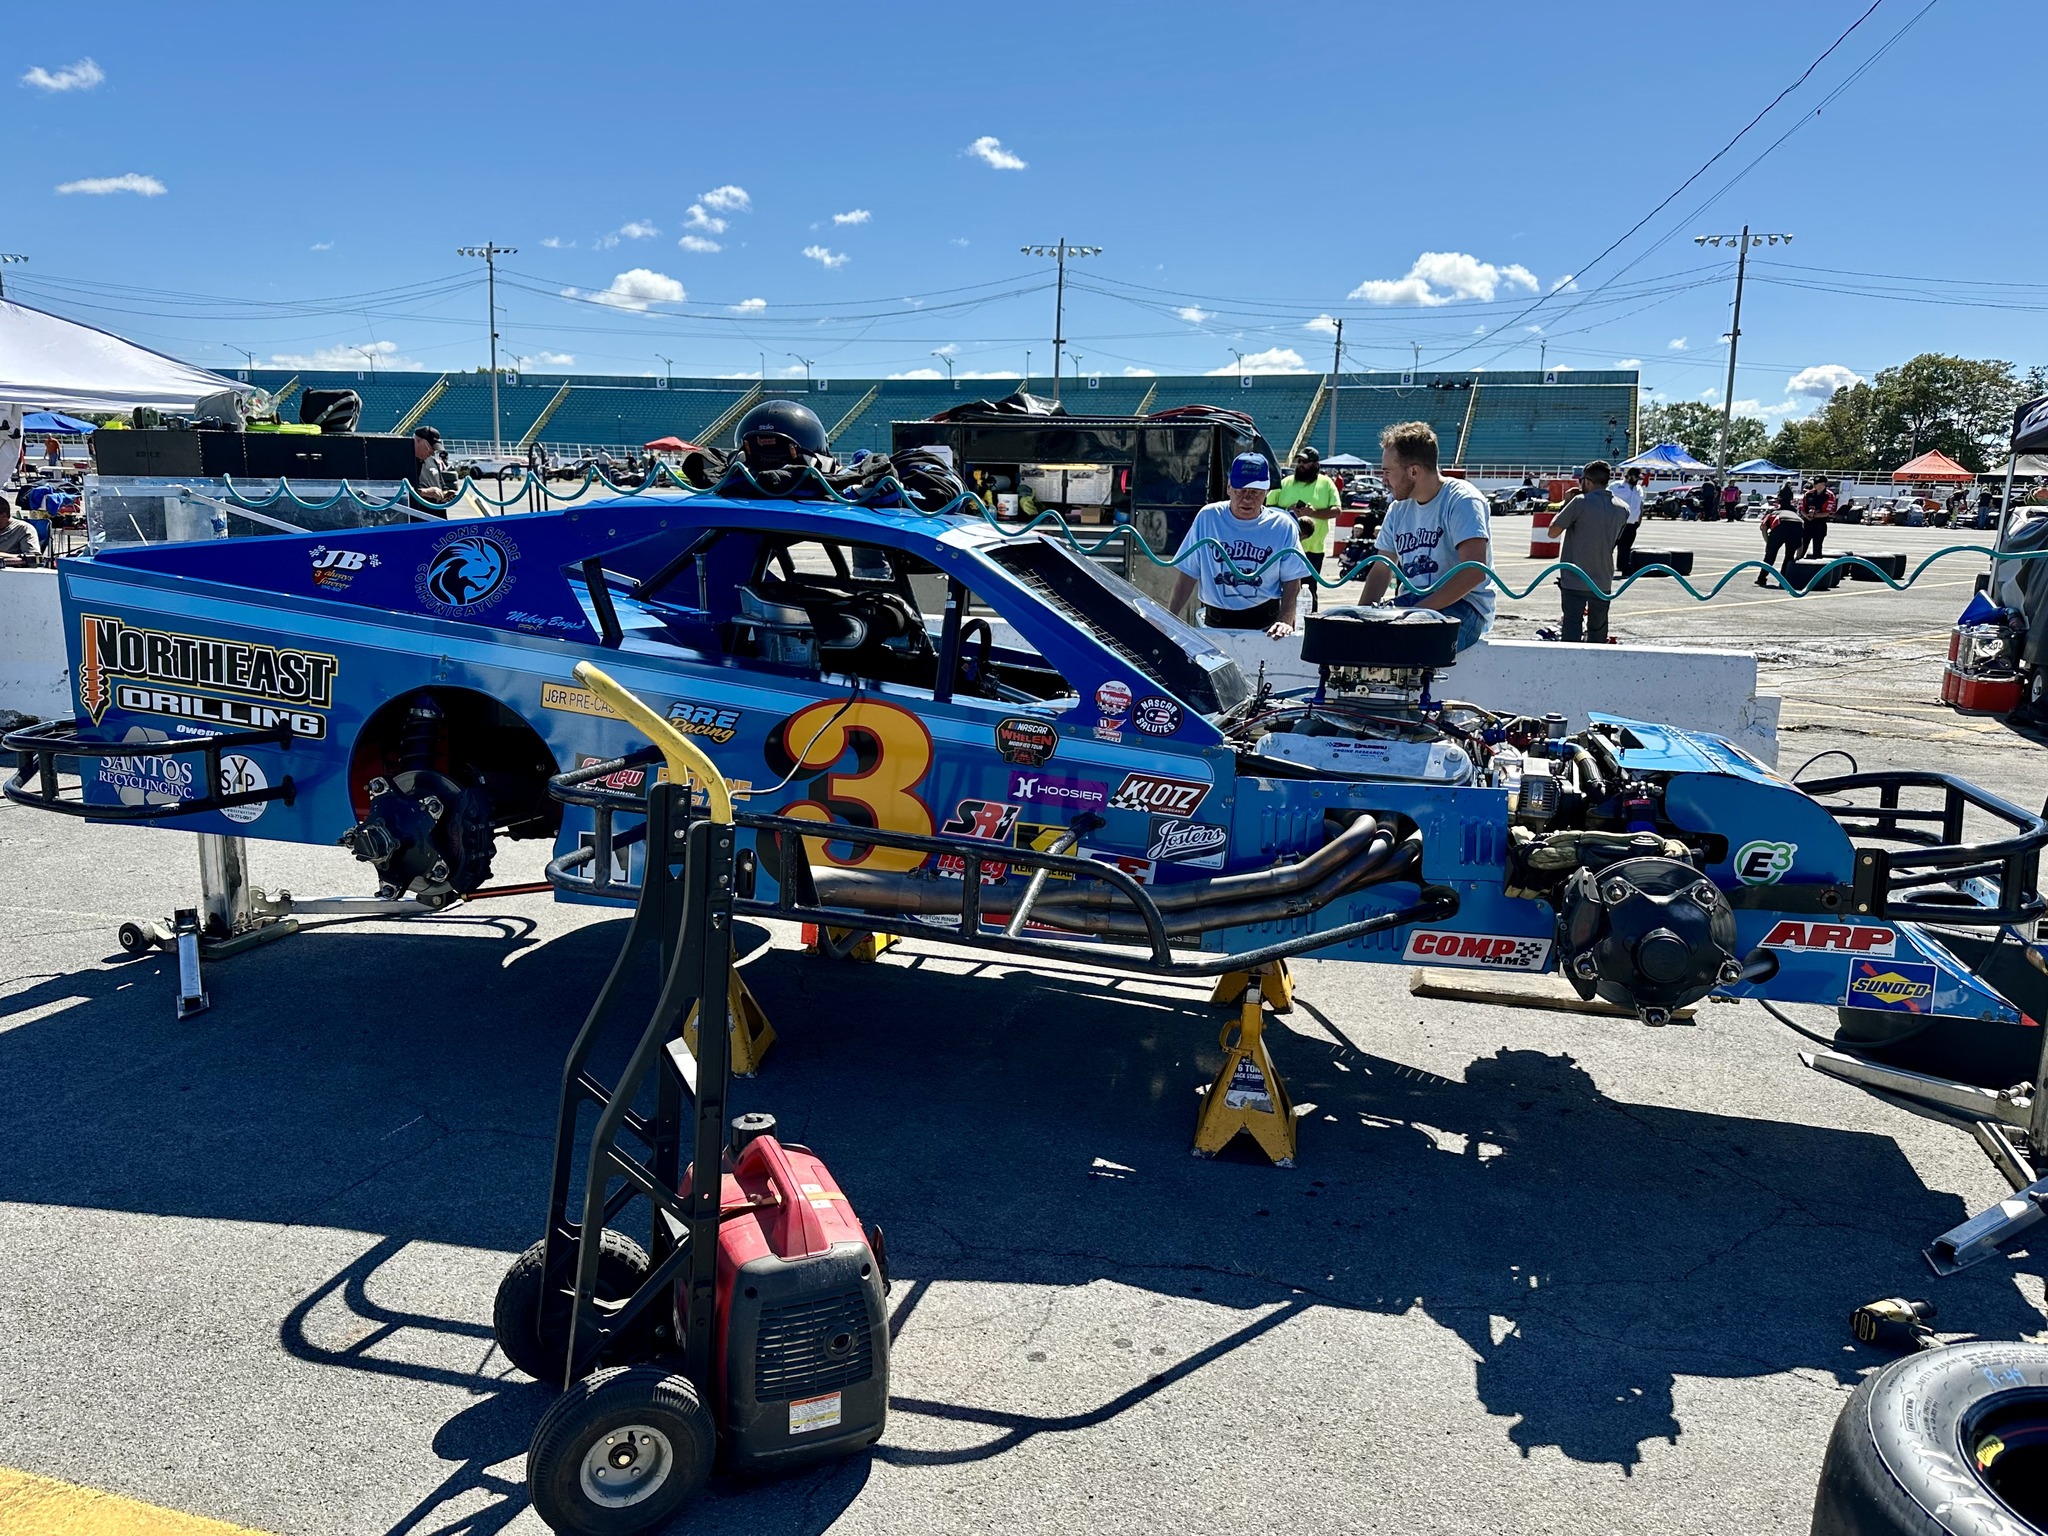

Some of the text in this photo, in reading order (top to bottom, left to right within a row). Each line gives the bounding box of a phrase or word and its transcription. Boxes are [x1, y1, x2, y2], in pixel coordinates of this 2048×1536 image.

[431, 525, 521, 561] LIONS SHARE
[312, 550, 367, 570] JB
[414, 563, 517, 618] COMMUNICATIONS
[506, 611, 547, 626] Mikey
[86, 617, 335, 704] NORTHEAST
[545, 689, 567, 705] J&R
[1141, 699, 1178, 714] NASCAR
[121, 688, 321, 735] DRILLING
[669, 703, 740, 728] BRE
[1000, 728, 1053, 746] WHELEN
[1016, 723, 1048, 735] NASCAR
[1136, 717, 1176, 734] SALUTES
[1008, 740, 1031, 749] MODIFIED
[101, 755, 193, 785] SANTOS
[98, 770, 195, 800] RECYCLING INC.
[777, 697, 936, 871] 3
[1037, 784, 1103, 802] HOOSIER
[1123, 780, 1201, 809] KLOTZ
[942, 800, 1021, 842] SRI
[1147, 820, 1226, 860] Jostens
[937, 853, 1008, 879] Hoey
[920, 913, 940, 922] PISTON
[941, 915, 959, 923] RINGS
[1412, 934, 1516, 959] COMP
[1763, 922, 1894, 950] ARP
[1480, 955, 1532, 967] CAMS
[1857, 979, 1929, 997] SUNOCO
[1916, 1370, 1935, 1386] SAFETY
